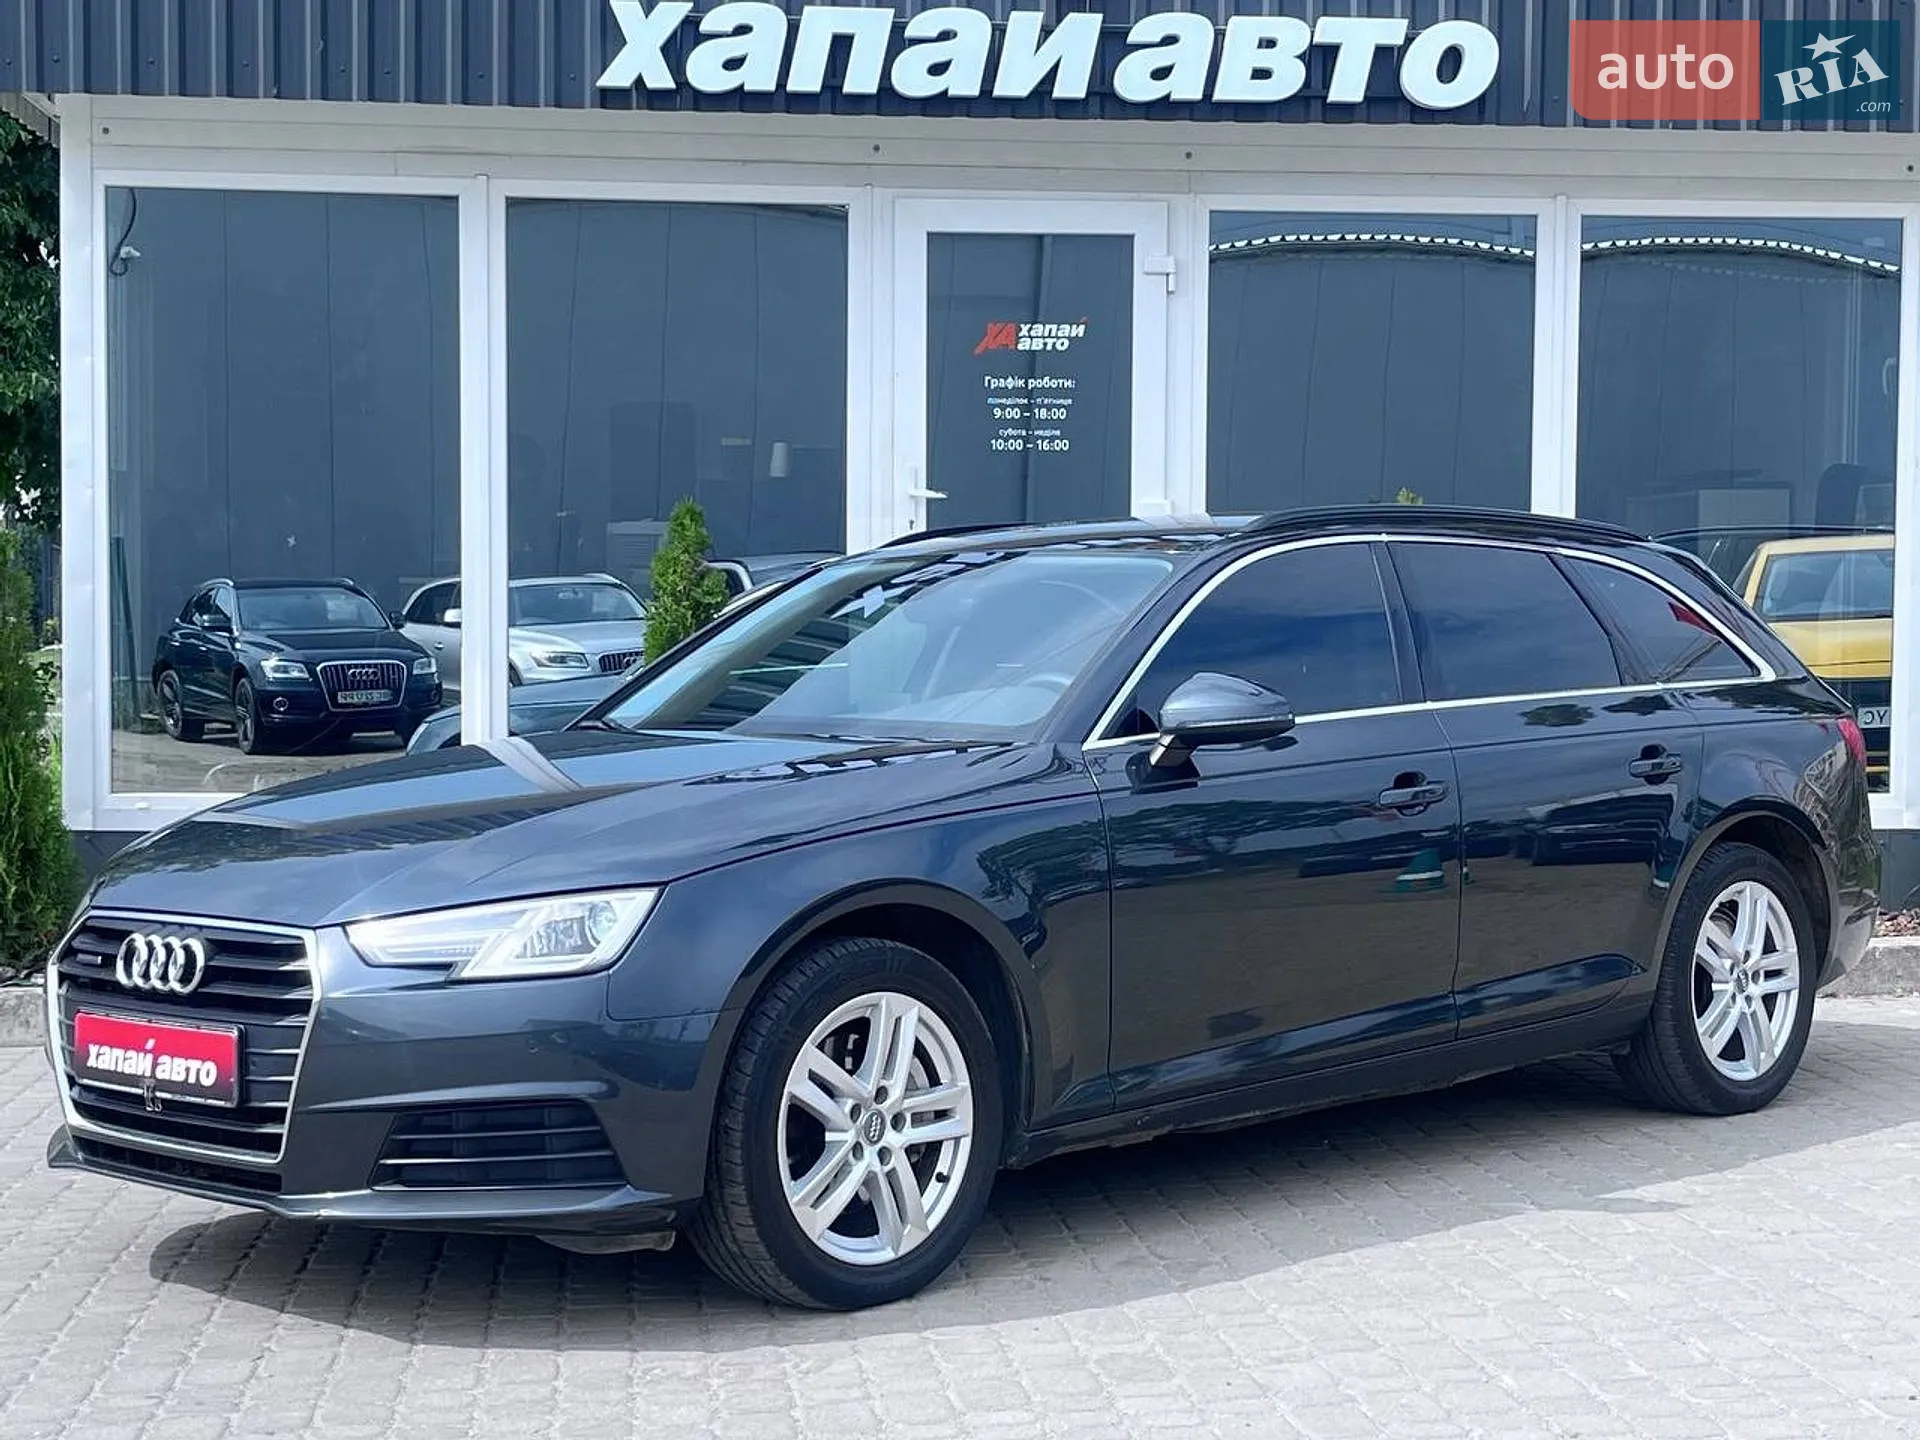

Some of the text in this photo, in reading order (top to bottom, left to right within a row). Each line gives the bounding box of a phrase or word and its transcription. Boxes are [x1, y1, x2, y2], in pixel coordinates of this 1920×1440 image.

[1112, 11, 1501, 110] авто
[1017, 338, 1070, 351] авто
[984, 376, 1076, 390] Графік роботи:
[993, 407, 1021, 420] 9:00
[1033, 407, 1067, 420] 18:00
[999, 427, 1027, 438] субота
[990, 439, 1024, 451] 10:00
[1036, 439, 1070, 451] 16:00
[86, 1037, 217, 1087] хапай авто
